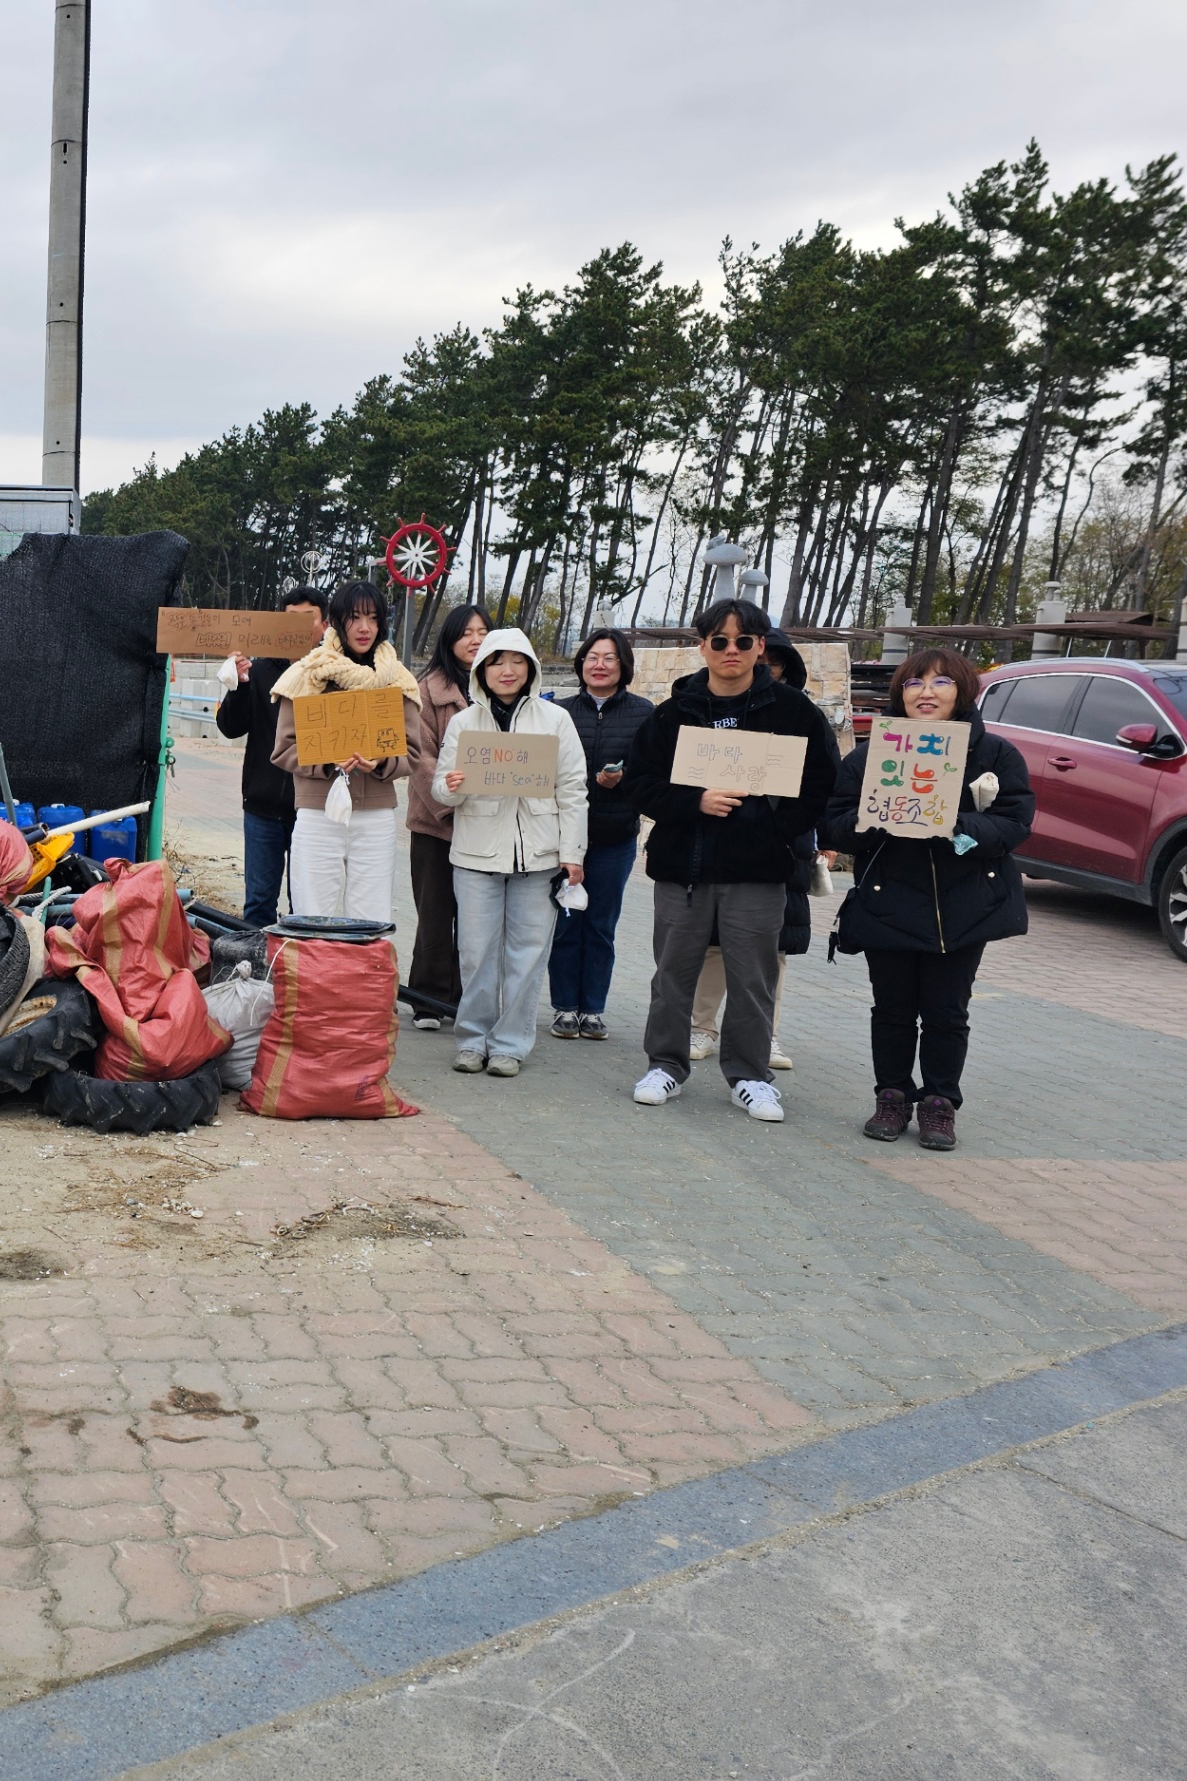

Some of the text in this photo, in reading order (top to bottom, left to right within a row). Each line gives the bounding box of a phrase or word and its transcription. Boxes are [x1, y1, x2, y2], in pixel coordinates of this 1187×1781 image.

[304, 724, 366, 756] 지키자
[697, 743, 743, 764] 바다
[883, 732, 951, 756] 가치
[484, 771, 506, 785] 바다
[720, 764, 767, 792] 사랑
[880, 759, 938, 794] 있는
[867, 789, 948, 827] 협동조합
